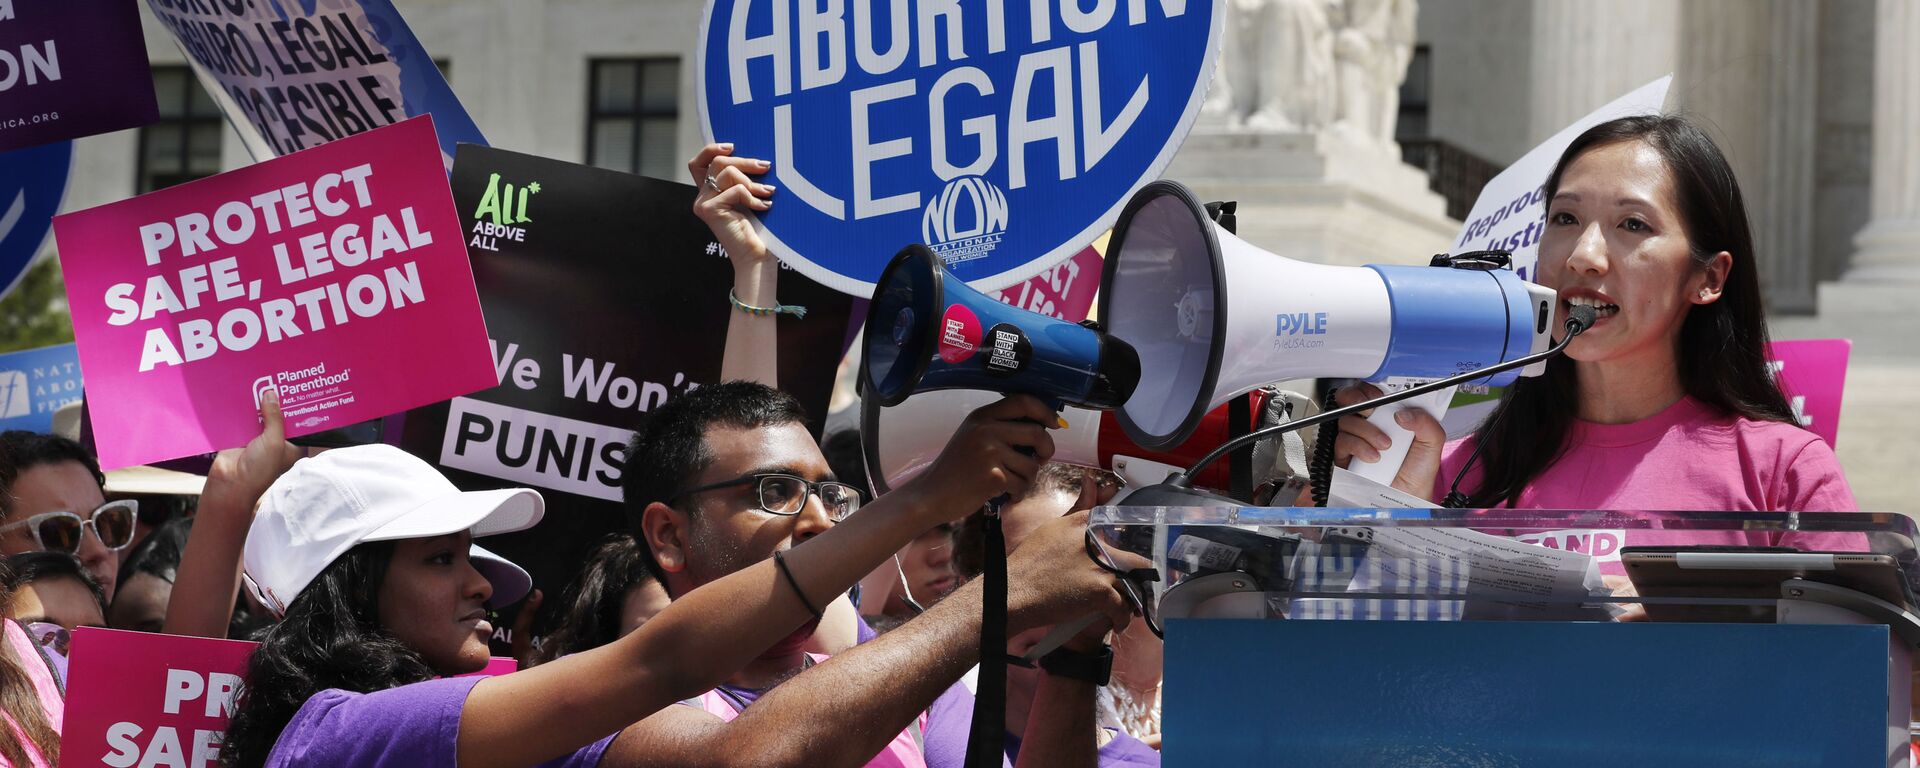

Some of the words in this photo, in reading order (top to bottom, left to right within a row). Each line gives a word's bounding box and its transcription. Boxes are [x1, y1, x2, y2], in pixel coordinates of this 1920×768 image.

[255, 12, 388, 76] LEGAL
[728, 0, 1187, 105] ABOR
[0, 112, 59, 129] ICA.ORG
[774, 40, 1149, 221] LEGAL
[139, 163, 373, 266] PROTECT
[922, 177, 1008, 246] NOW
[470, 234, 499, 251] ALL
[472, 220, 526, 242] ABOVE
[930, 235, 1002, 253] NATIONAL
[104, 256, 262, 326] SAFE,
[272, 206, 433, 286] LEGAL
[138, 261, 425, 373] ABORTION
[996, 340, 1013, 349] WITH
[997, 331, 1018, 342] STAND
[991, 357, 1018, 368] WOMEN
[994, 349, 1015, 359] BLACK
[277, 362, 325, 384] Planned
[279, 370, 349, 397] Parenthood
[283, 404, 319, 418] Parenthood
[319, 400, 339, 410] Action
[339, 395, 355, 405] Fund
[1520, 532, 1618, 557] AND
